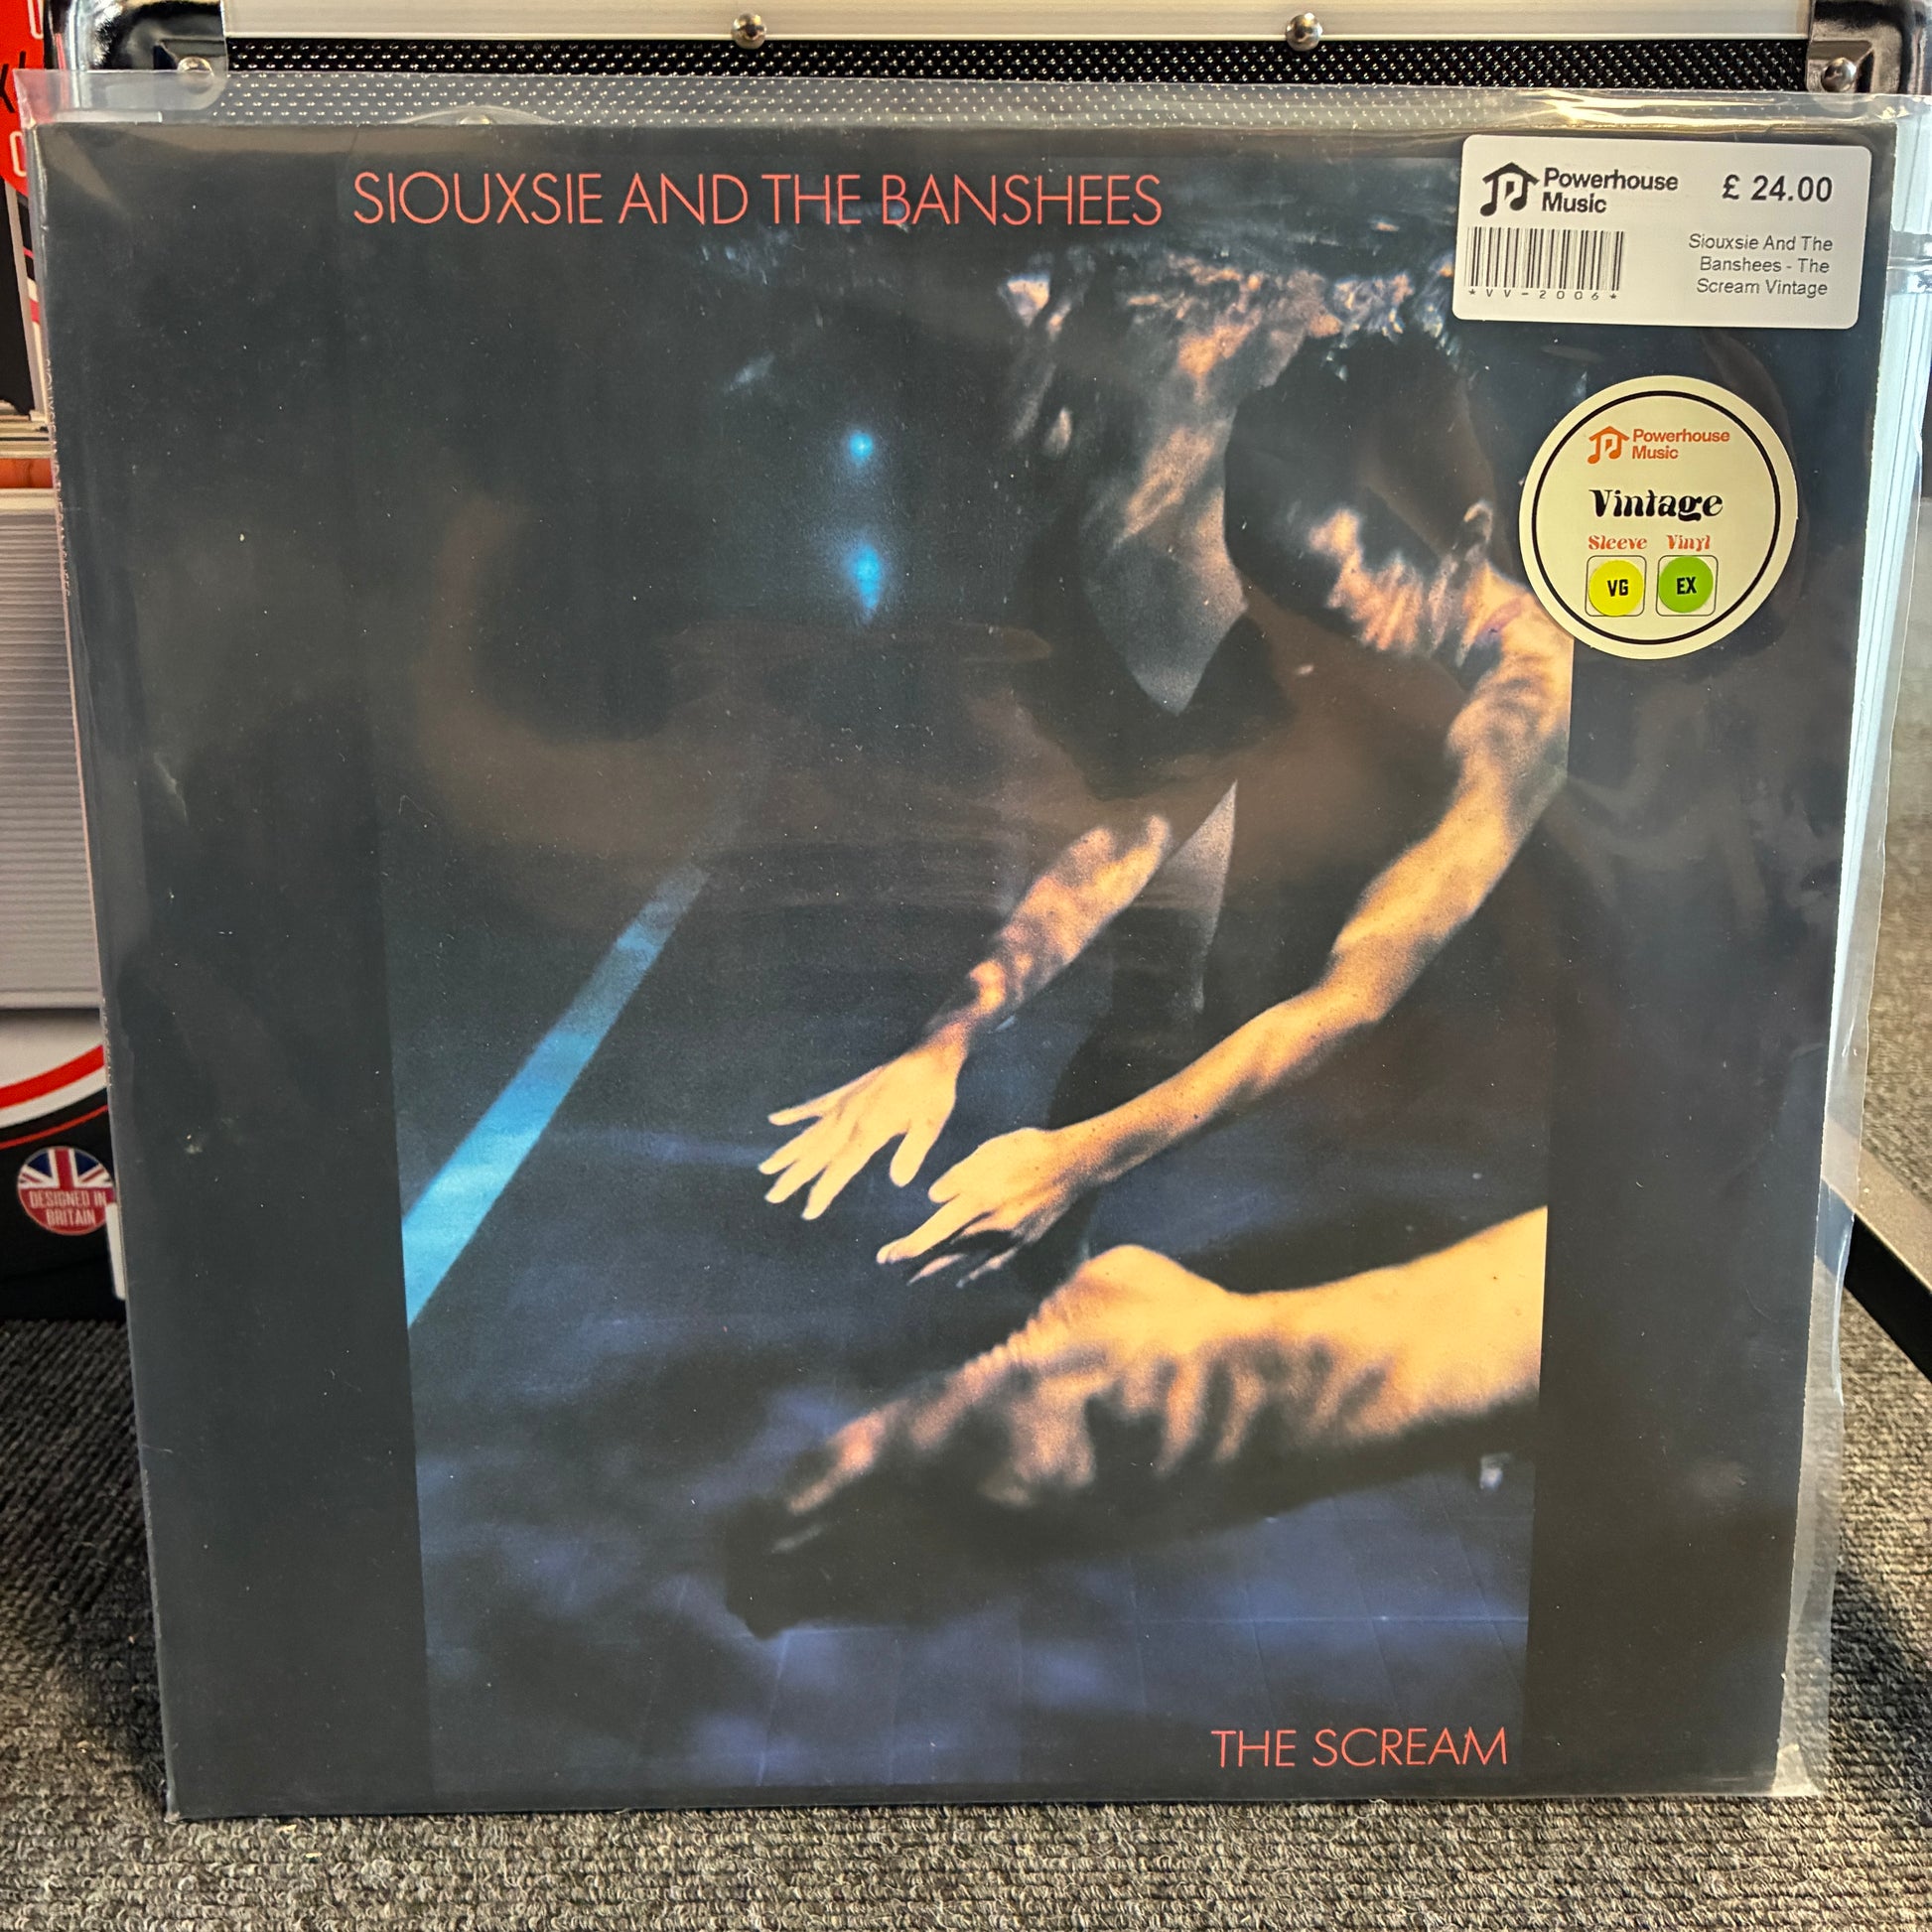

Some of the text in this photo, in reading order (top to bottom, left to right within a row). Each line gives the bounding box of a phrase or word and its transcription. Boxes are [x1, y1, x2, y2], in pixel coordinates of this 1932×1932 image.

[1544, 167, 1679, 192] Powerhouse
[1722, 175, 1834, 203] £ 24.00
[353, 172, 1163, 226] SIOUXSIE AND THE BANSHEES
[1542, 192, 1607, 214] Music
[1688, 233, 1834, 252] Siouxsie And The
[1700, 257, 1783, 274] Banshees
[1798, 258, 1831, 274] The
[1696, 279, 1829, 299] Scream Vintage
[1632, 428, 1730, 444] Powerhouse
[1631, 445, 1680, 460] Music
[1587, 489, 1725, 522] Vintage
[1587, 534, 1712, 553] Sleeve Vinyl
[1606, 577, 1698, 598] VG EX
[28, 1189, 107, 1209] DESIGNED IN
[45, 1209, 97, 1227] BRITAIN
[1210, 1725, 1508, 1768] THE SCREAM
